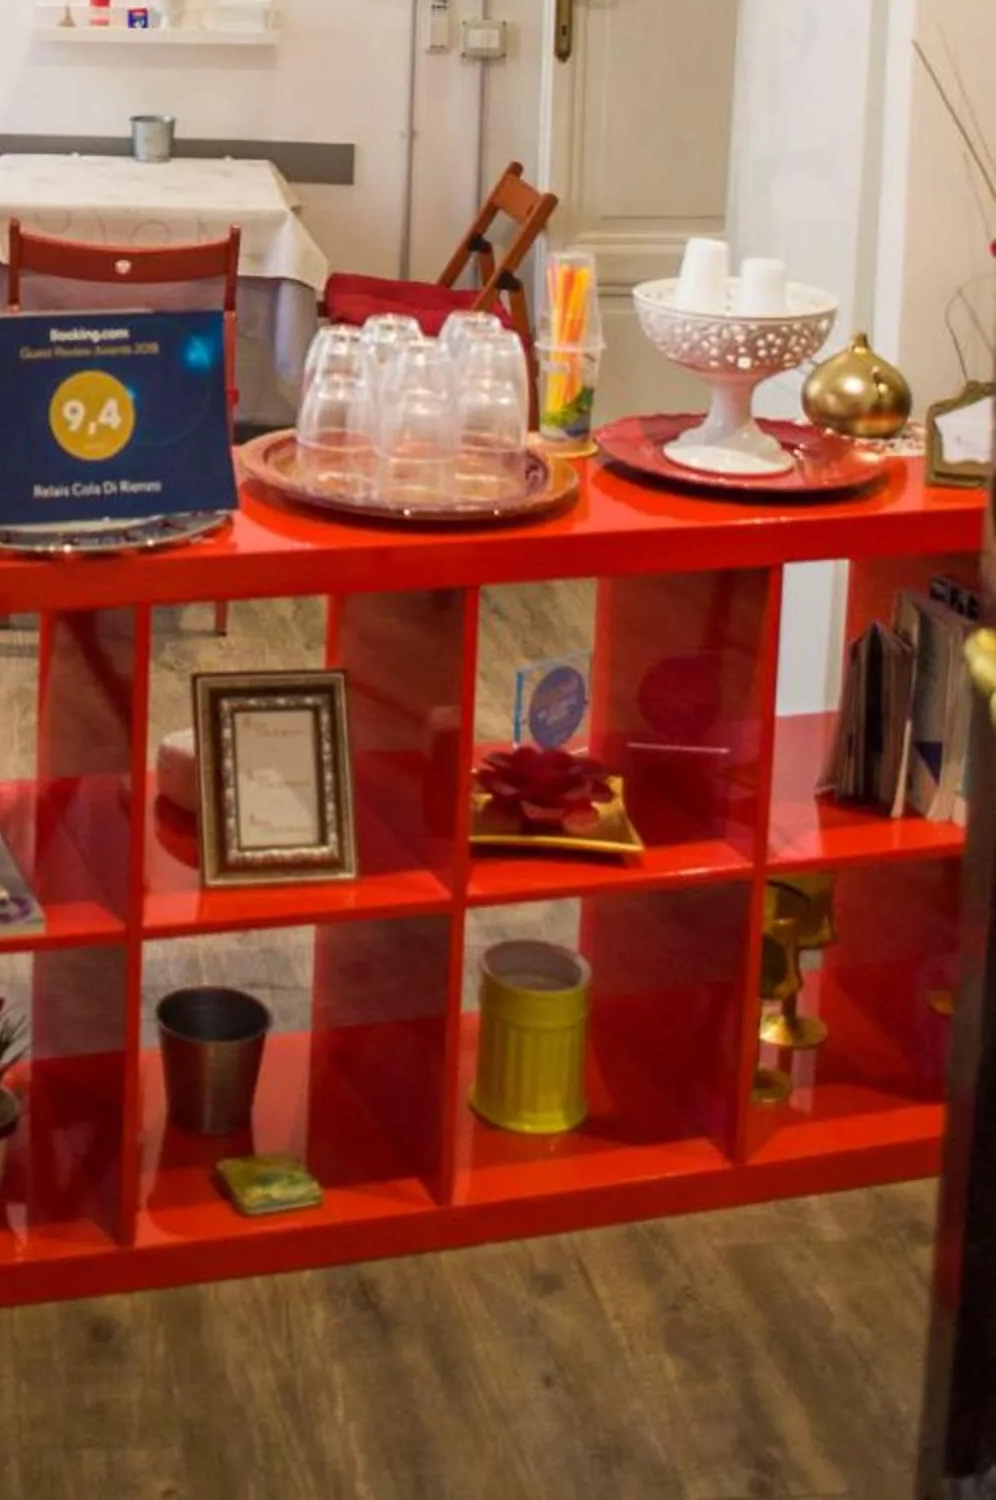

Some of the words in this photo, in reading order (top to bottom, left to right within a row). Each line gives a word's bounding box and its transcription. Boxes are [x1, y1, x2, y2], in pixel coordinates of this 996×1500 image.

[49, 329, 129, 342] Booking.com
[19, 345, 51, 359] Guest
[61, 397, 123, 437] 9,4
[33, 484, 70, 498] Relais
[71, 482, 101, 497] Cola
[103, 481, 117, 495] Di
